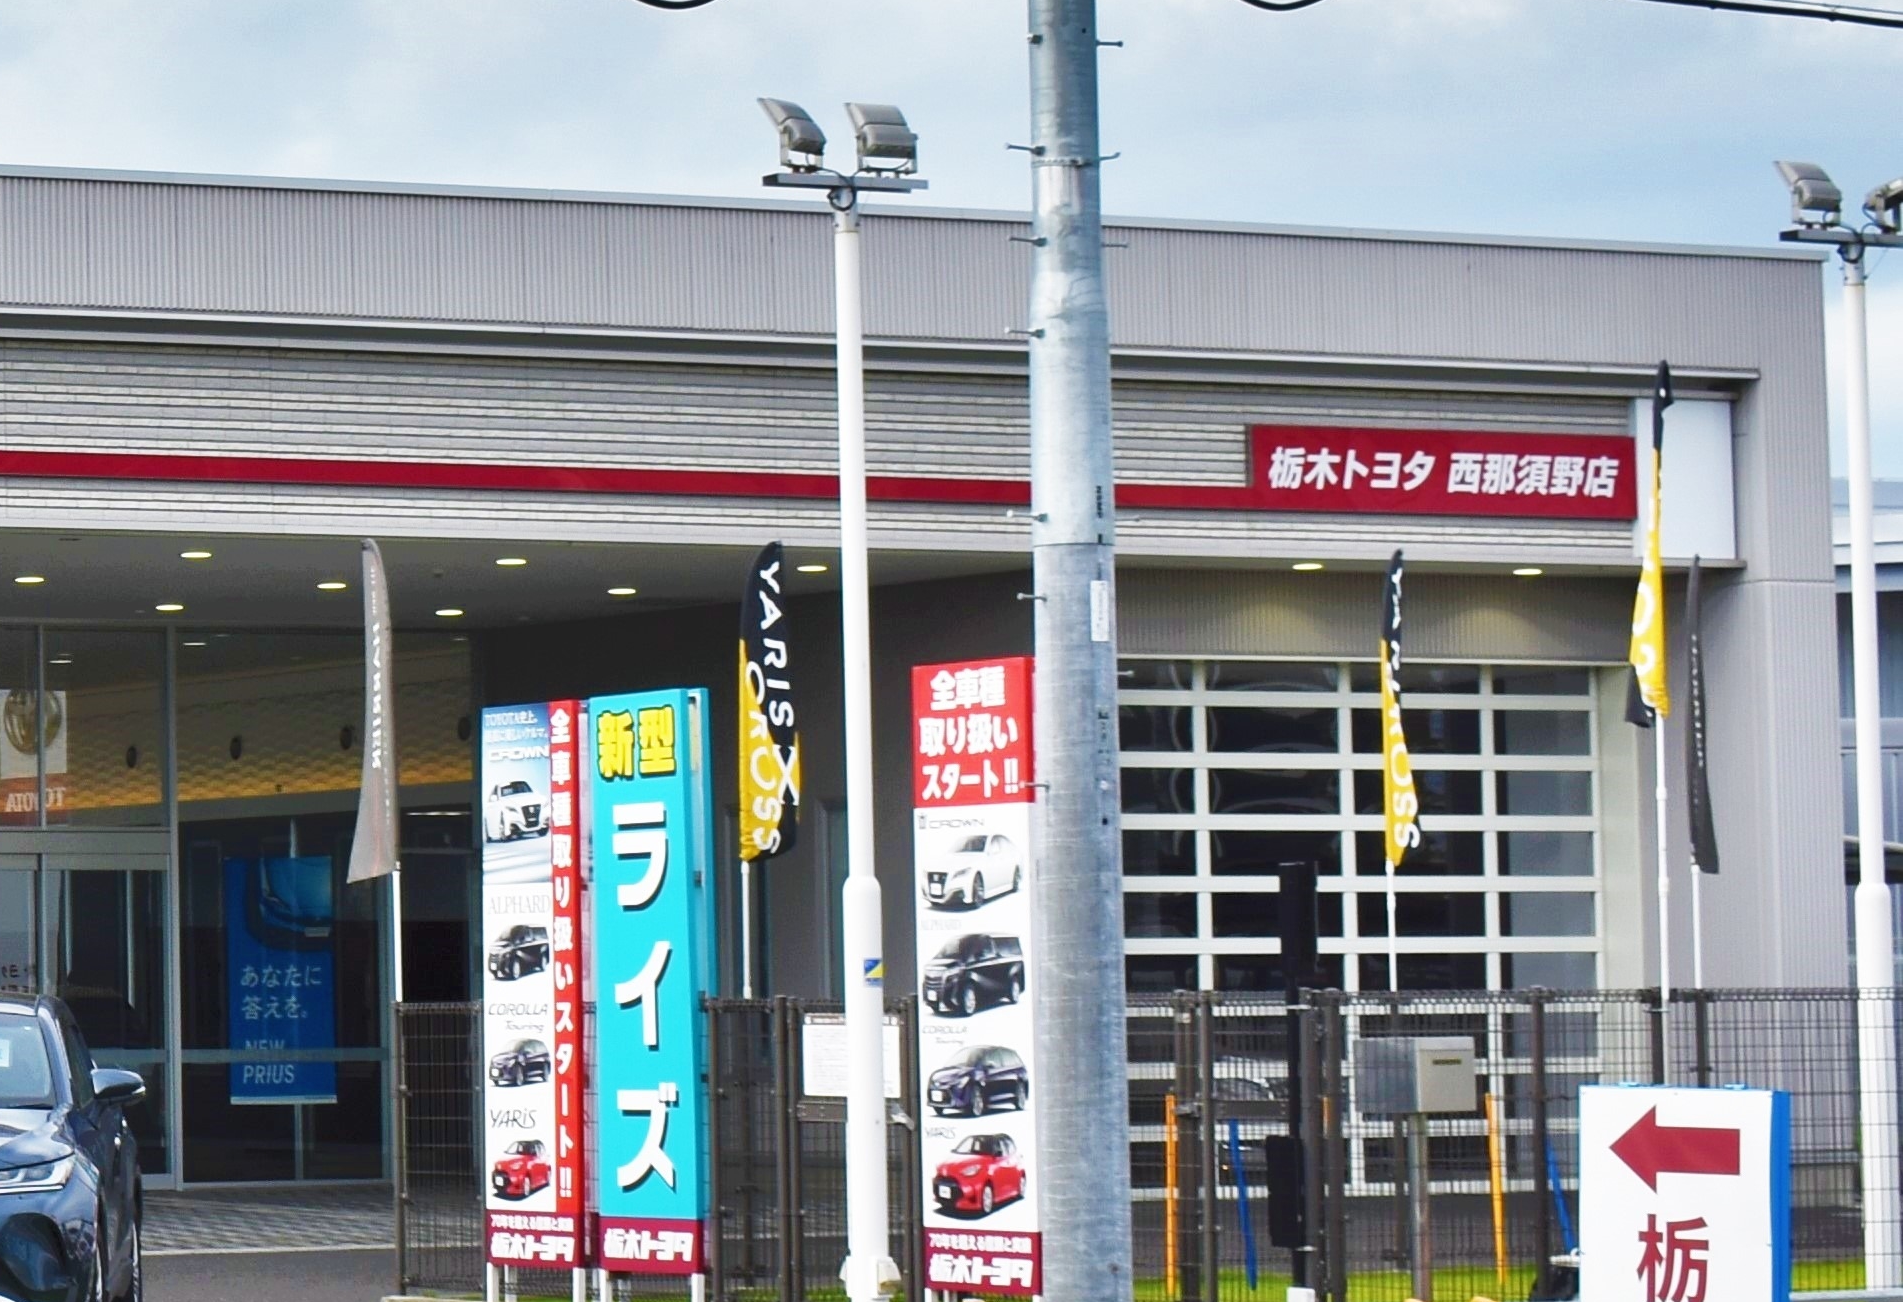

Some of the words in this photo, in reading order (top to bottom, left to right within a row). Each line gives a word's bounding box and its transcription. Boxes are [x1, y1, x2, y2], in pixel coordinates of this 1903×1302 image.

[1268, 446, 1436, 491] 栃木トヨタ
[1447, 452, 1620, 498] 西那須野店
[759, 561, 795, 728] YARIS
[930, 666, 1005, 711] 全車種
[596, 704, 677, 781] 新型
[919, 713, 1019, 758] 取り扱い
[488, 744, 550, 760] CROWN
[747, 660, 782, 854] CROSS
[929, 819, 985, 829] CROWN
[487, 895, 550, 915] ALPHARD
[241, 964, 322, 987] あなたに
[242, 996, 308, 1020] 答えを。
[488, 1003, 548, 1016] COROLLA
[611, 801, 677, 1190] ライズ
[505, 1020, 544, 1034] Touring
[244, 1065, 295, 1084] PRIUS
[491, 1232, 575, 1262] 栃木トヨタ
[604, 1228, 694, 1262] 栃木トヨタ
[929, 1253, 1033, 1288] 栃木トヨタ
